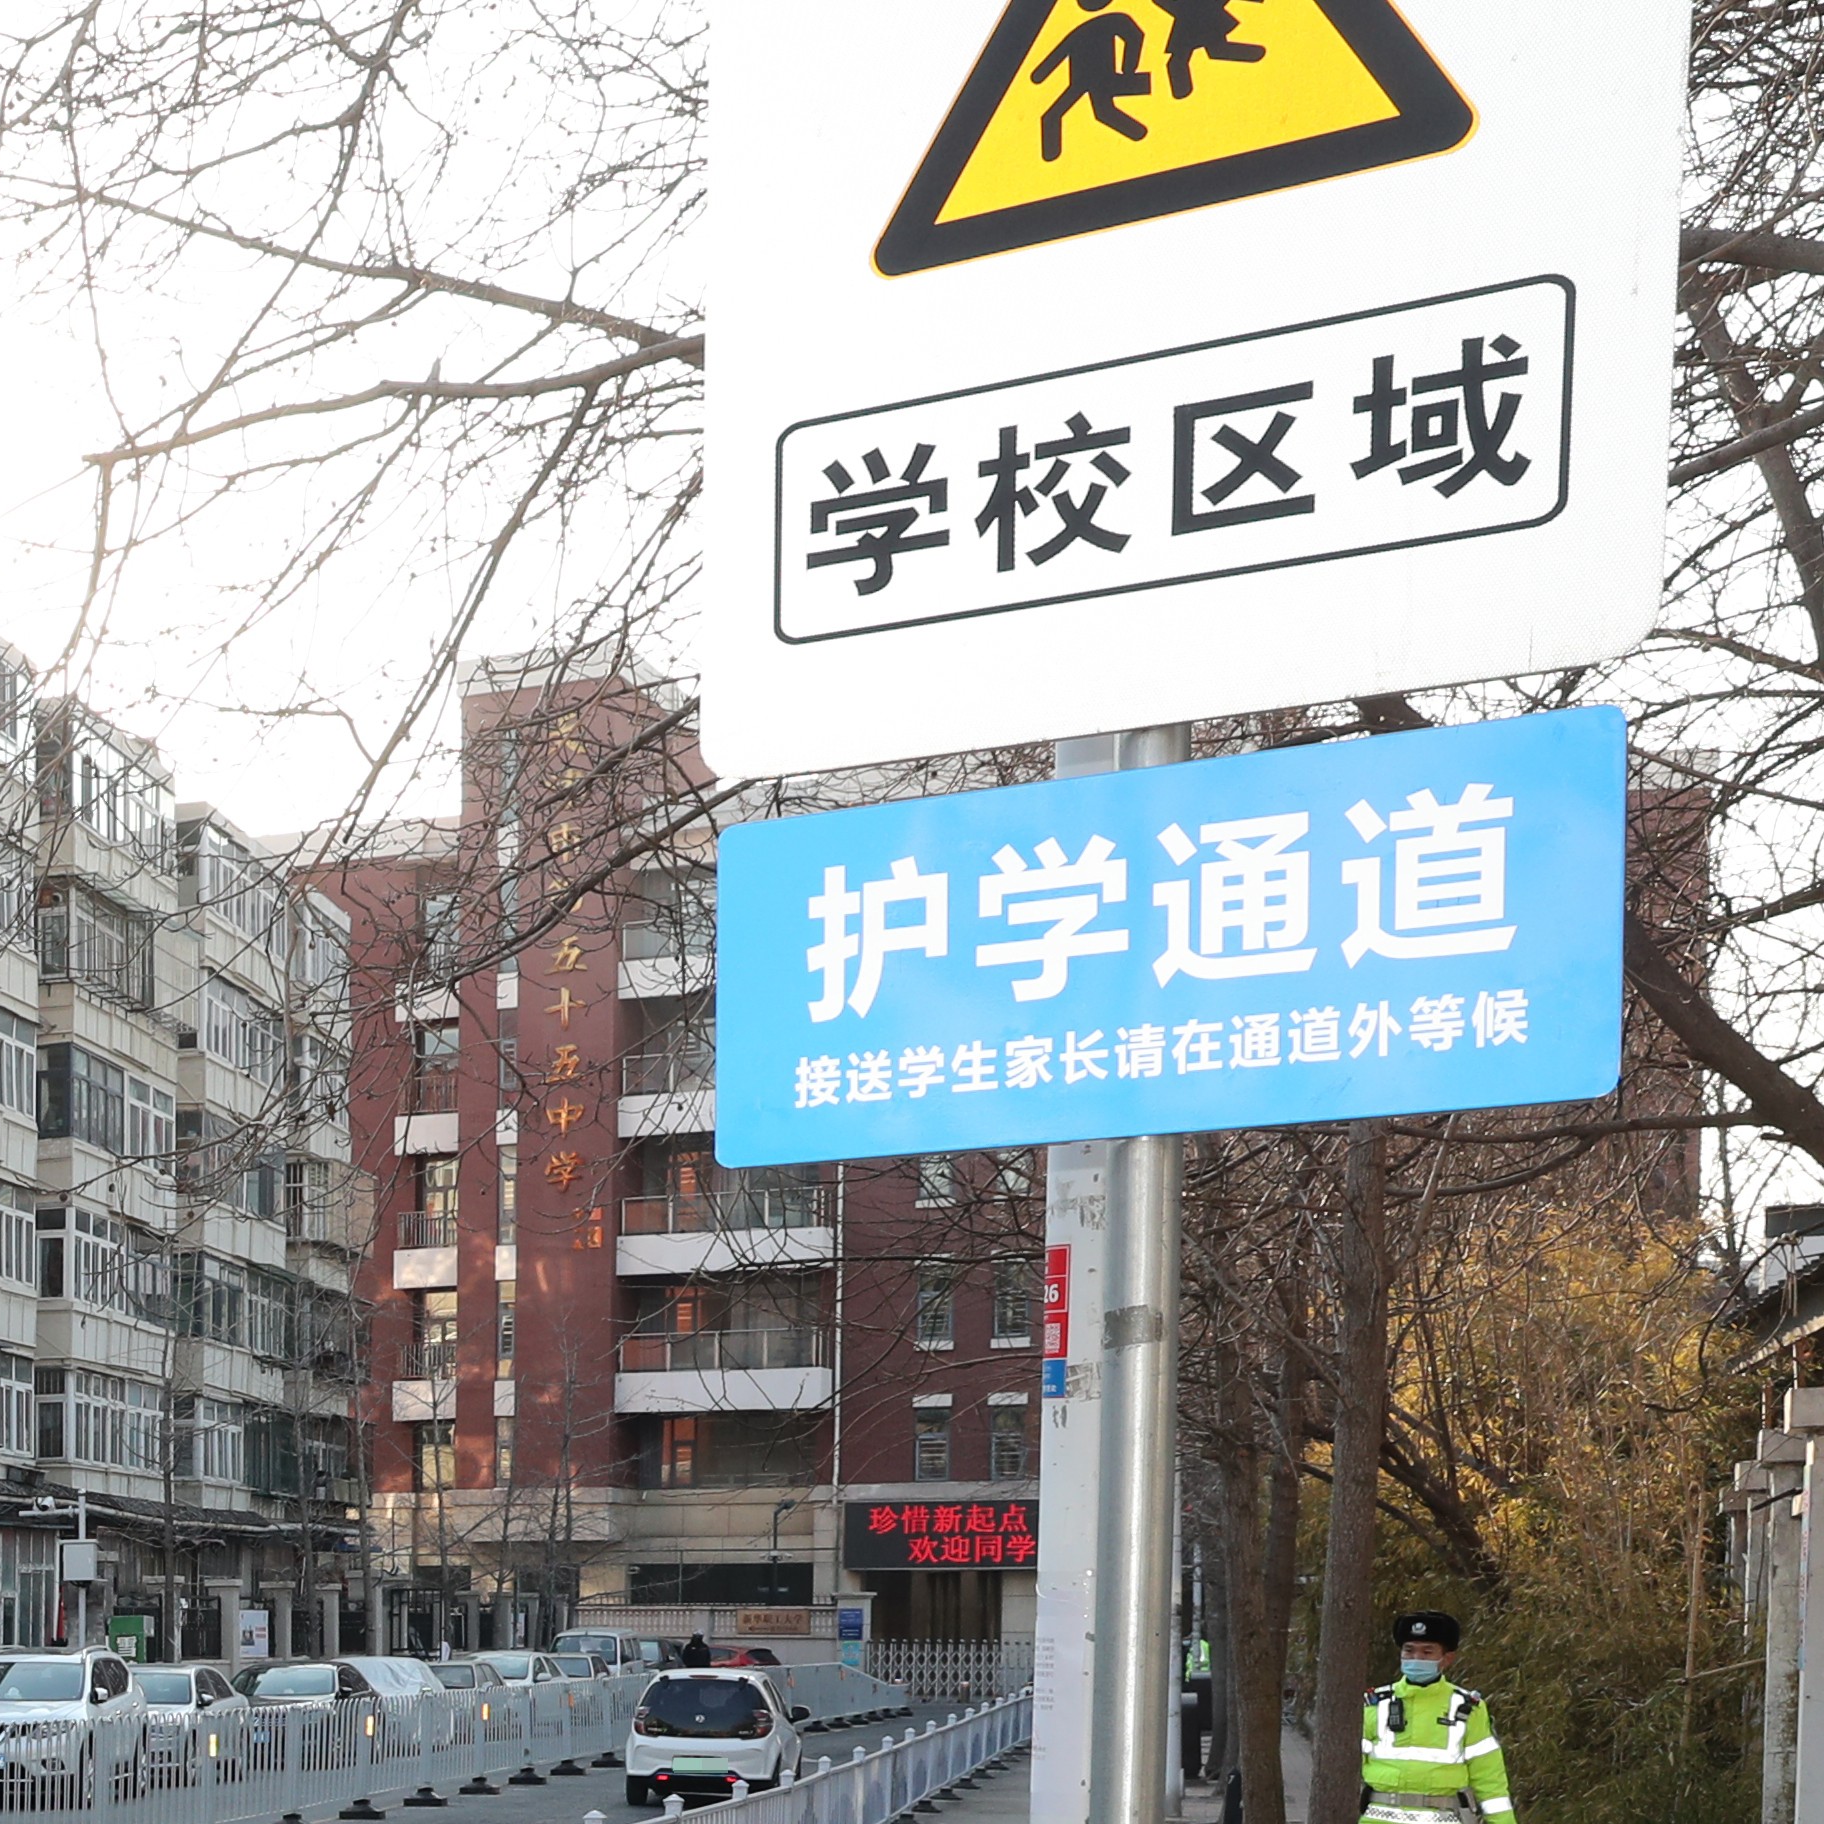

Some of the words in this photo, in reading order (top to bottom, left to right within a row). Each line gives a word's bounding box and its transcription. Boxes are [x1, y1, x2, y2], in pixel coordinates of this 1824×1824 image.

[805, 334, 1532, 596] 学校区域
[805, 782, 1519, 1024] 护学通道
[793, 986, 1532, 1112] 接送学生家长请在通道外等候
[868, 1503, 1028, 1535] 珍惜新起点
[907, 1535, 1036, 1564] 欢迎同学
